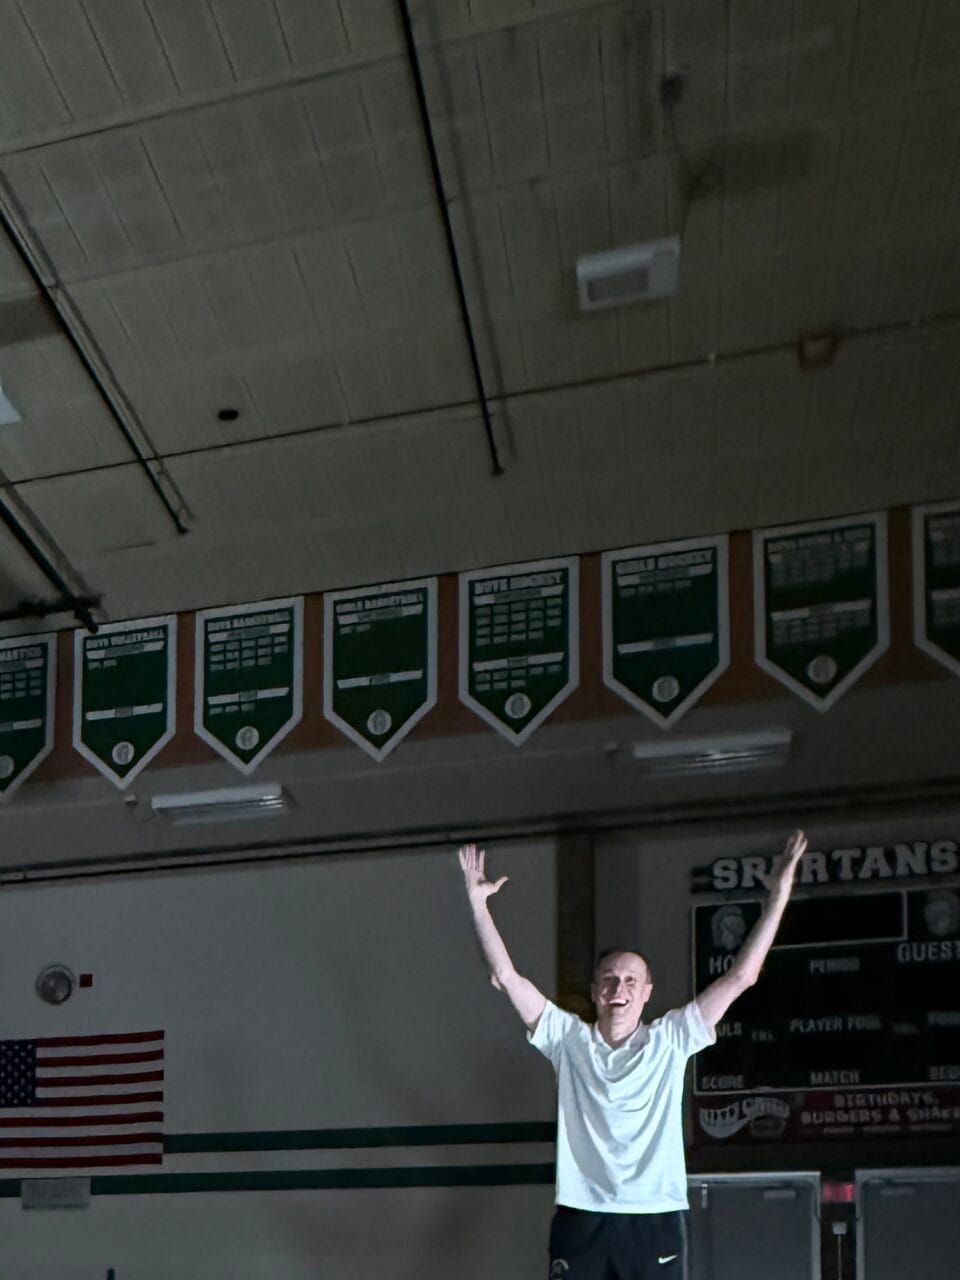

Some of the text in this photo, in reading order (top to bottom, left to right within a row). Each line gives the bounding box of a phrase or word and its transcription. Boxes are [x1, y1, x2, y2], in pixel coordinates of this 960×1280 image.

[712, 839, 959, 890] SPRTANS
[808, 957, 861, 974] PERIOD
[790, 1015, 843, 1033] PLAYER
[810, 1070, 861, 1086] MATCH
[800, 1107, 882, 1125] BURGERS
